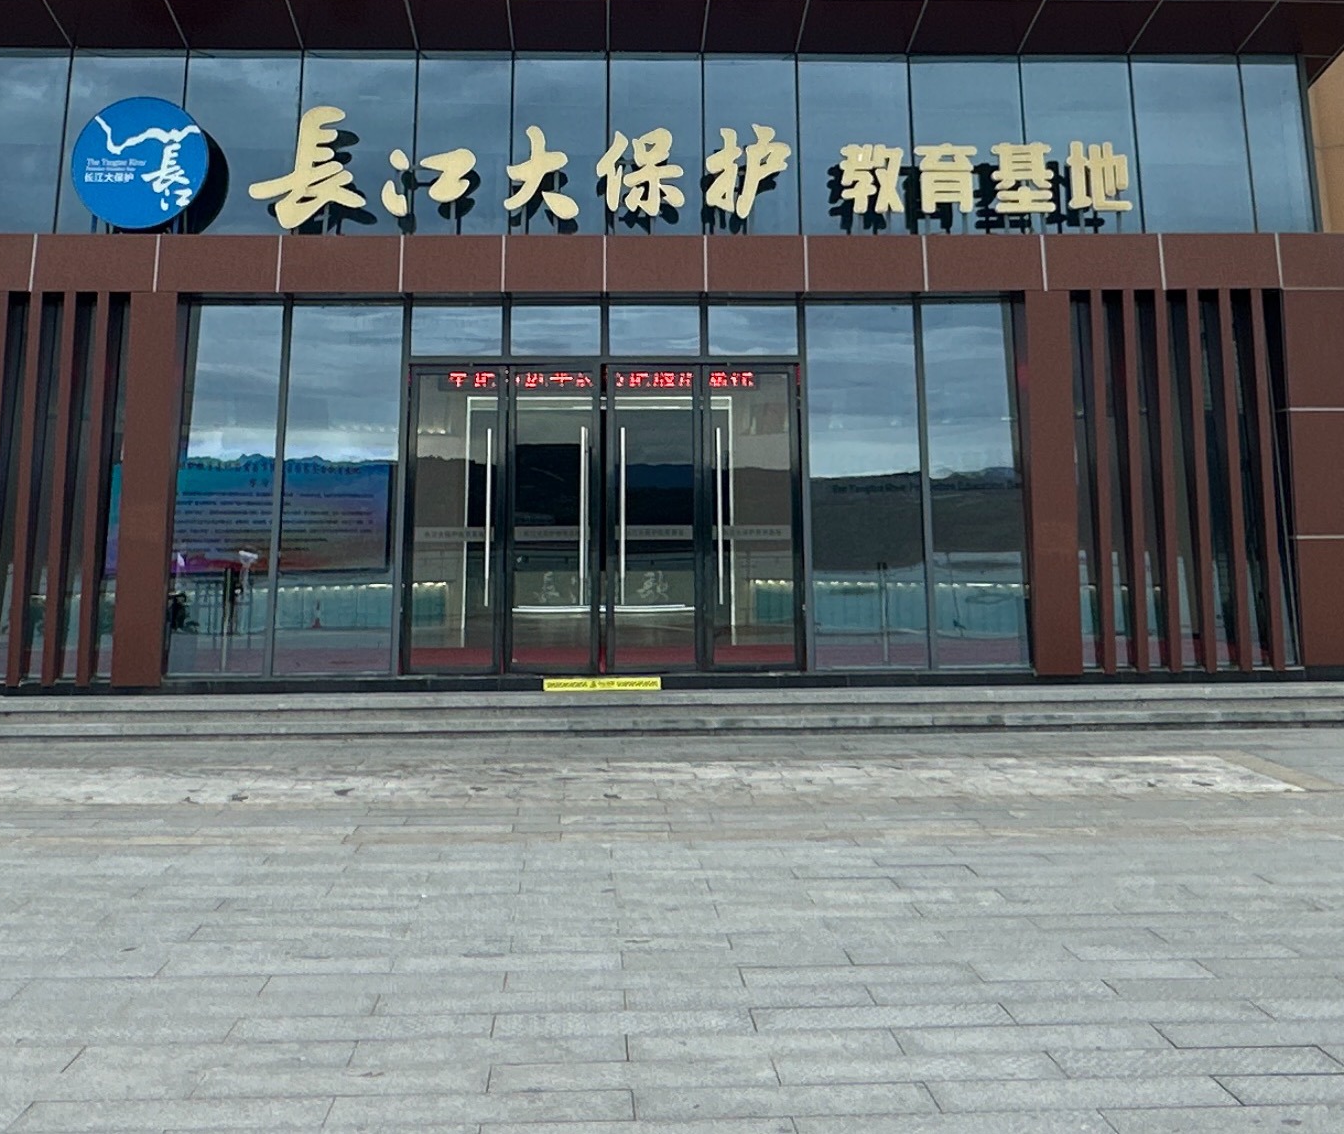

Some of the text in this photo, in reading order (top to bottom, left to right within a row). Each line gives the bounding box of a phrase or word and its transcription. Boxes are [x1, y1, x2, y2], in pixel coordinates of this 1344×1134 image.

[84, 172, 134, 183] 长江大保护
[839, 141, 1133, 214] 教育基地
